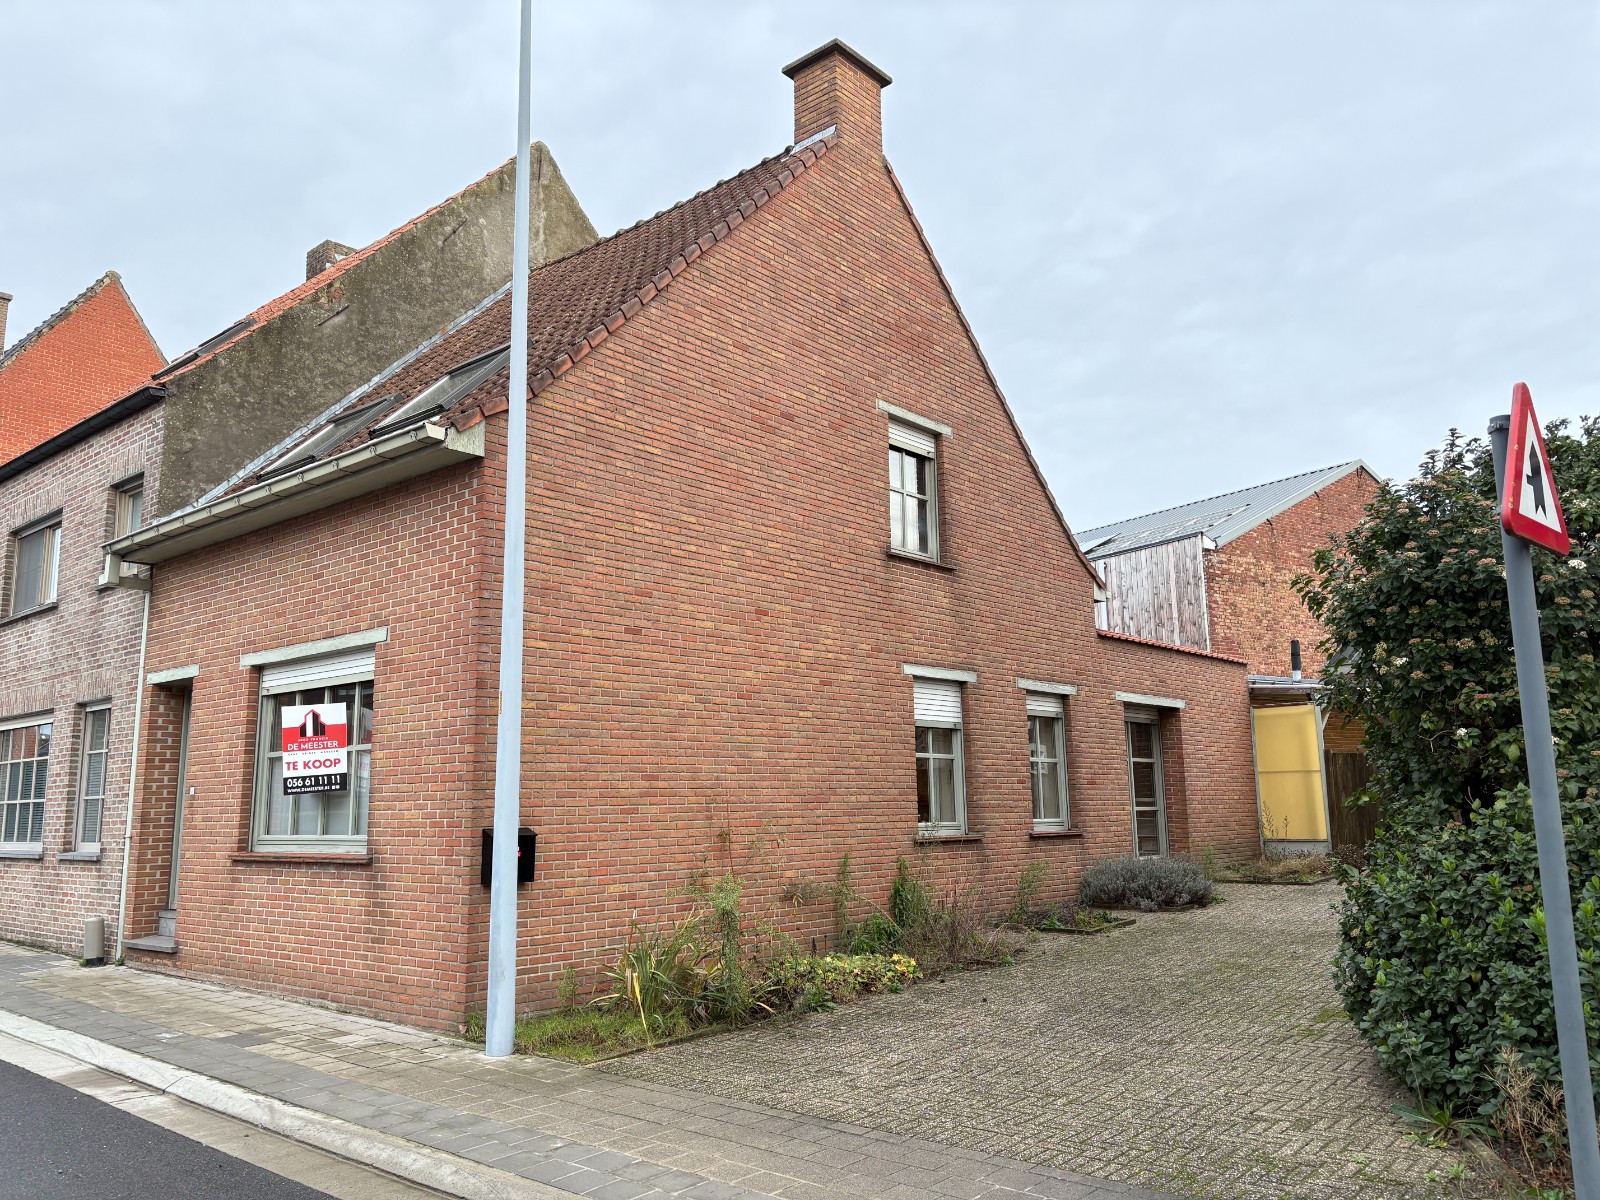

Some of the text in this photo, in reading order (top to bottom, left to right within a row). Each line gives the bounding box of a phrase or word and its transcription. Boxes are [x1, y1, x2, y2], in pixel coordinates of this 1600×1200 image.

[287, 743, 299, 751] DE
[300, 740, 339, 750] MEESTER
[285, 758, 341, 771] TE KOOP
[287, 775, 340, 787] 056 61 11 11
